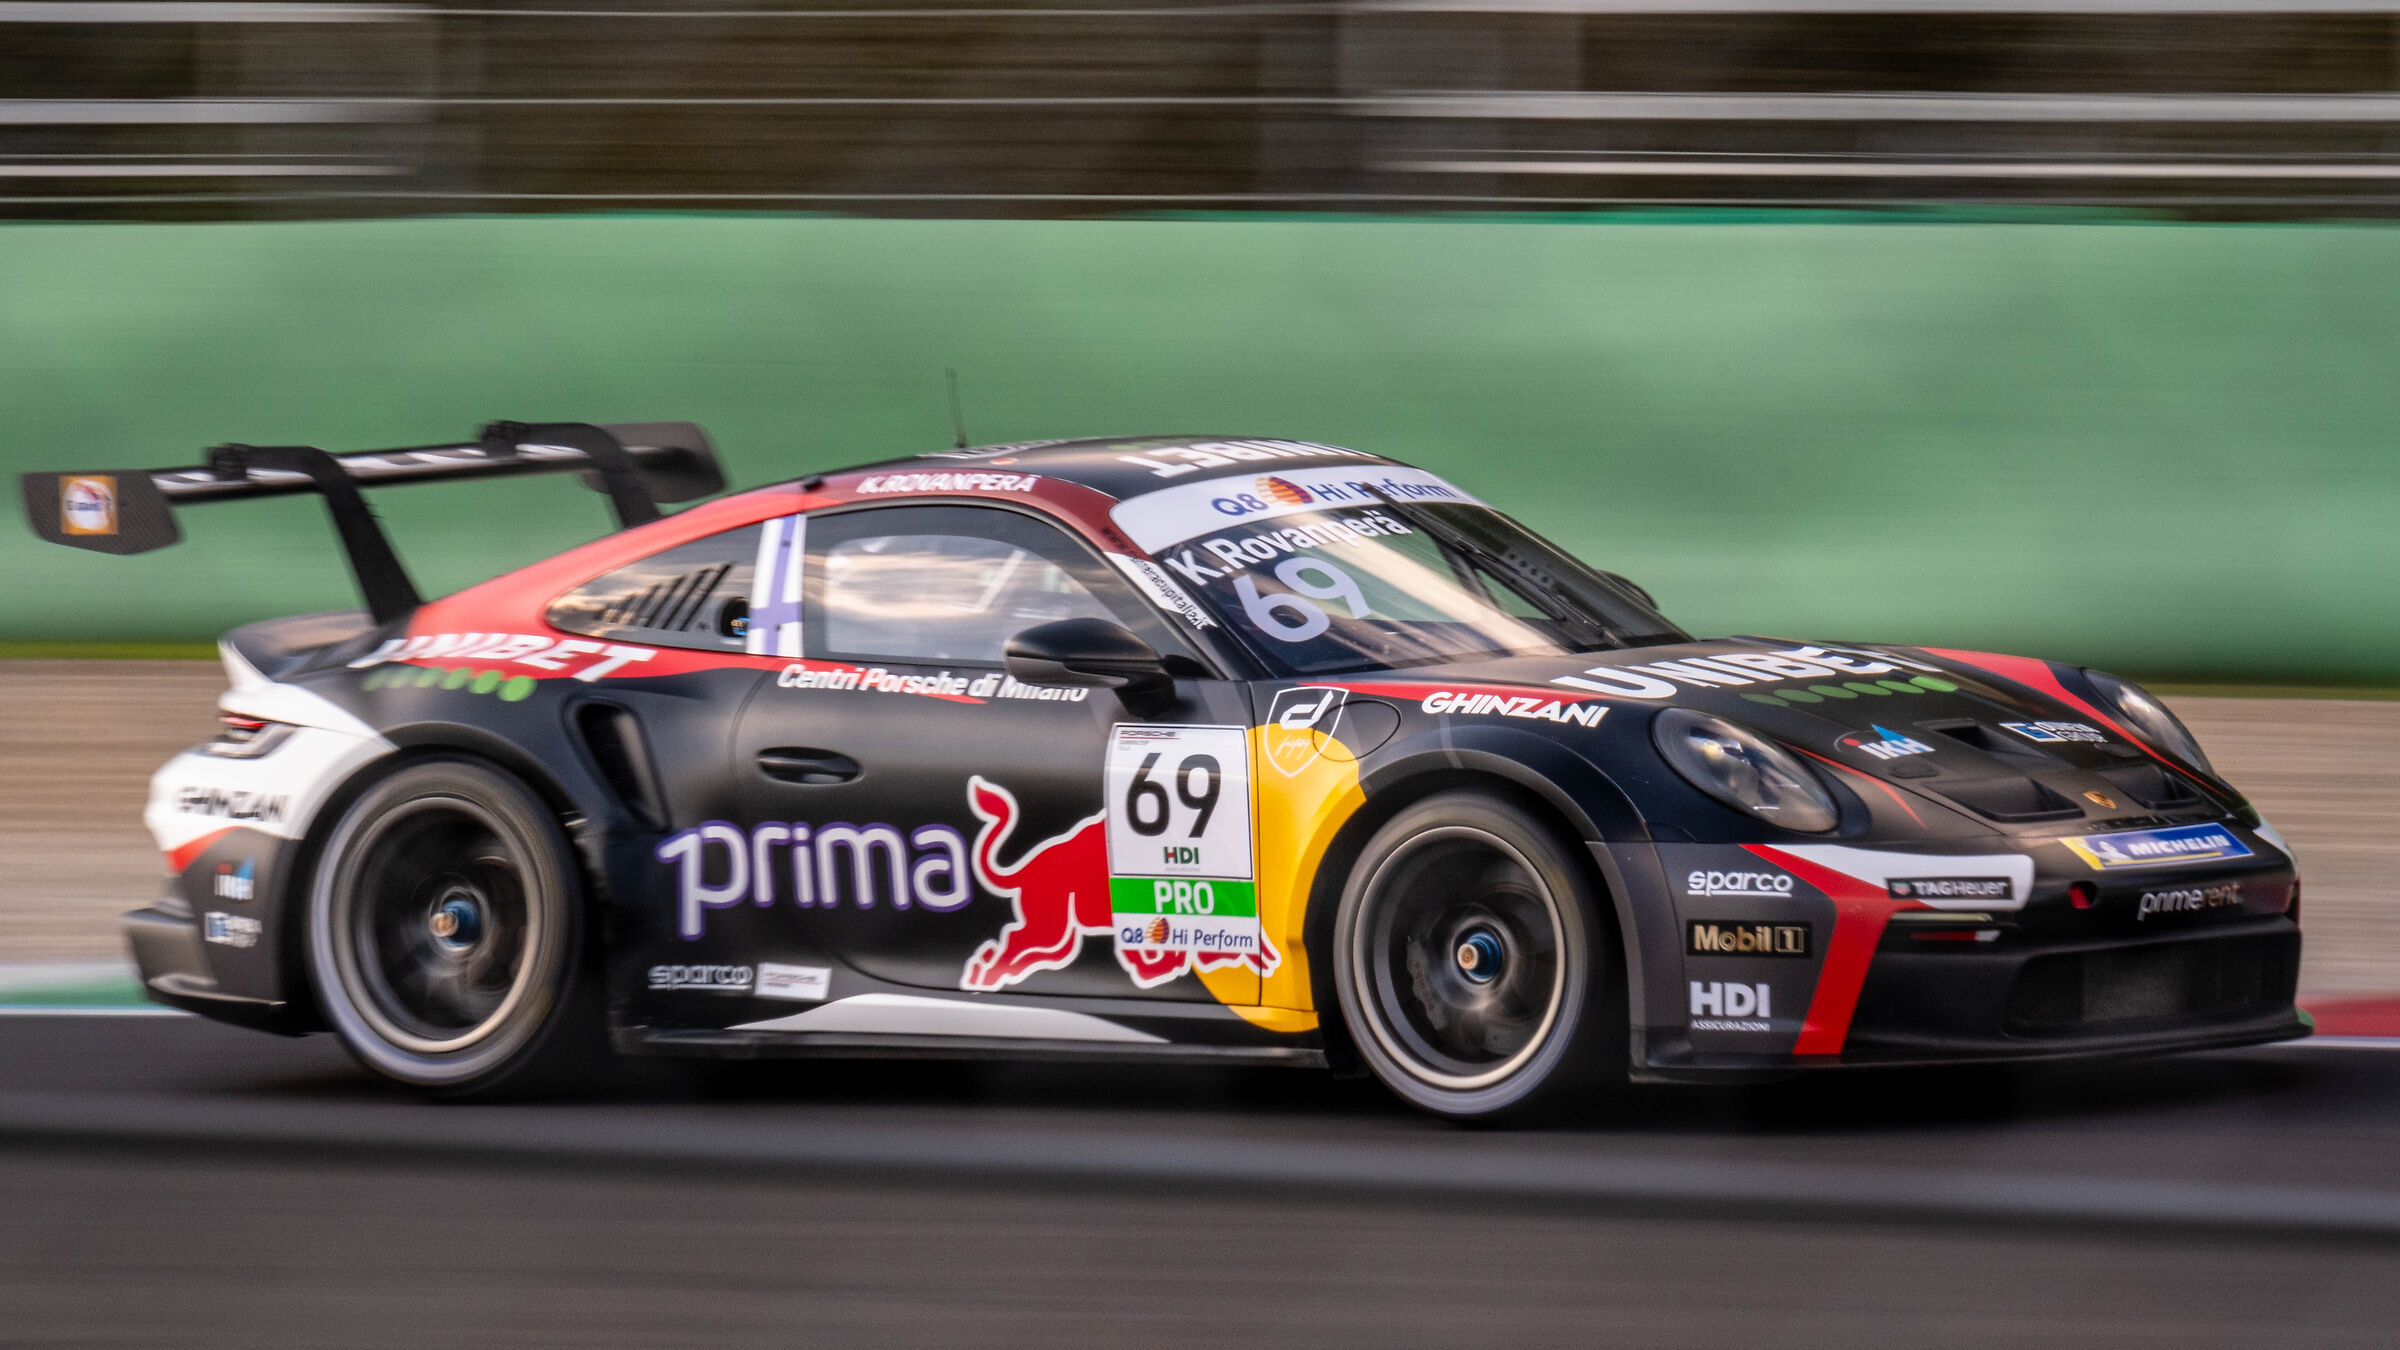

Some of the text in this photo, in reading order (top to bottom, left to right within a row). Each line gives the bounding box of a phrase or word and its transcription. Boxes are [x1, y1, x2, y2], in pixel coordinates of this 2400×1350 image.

[1211, 493, 1269, 516] Q8
[1307, 483, 1350, 502] Hi
[1165, 510, 1413, 586] K.Rovanperä
[1232, 556, 1372, 643] 69
[346, 632, 658, 683] UNIBET
[1549, 646, 1943, 699] UNIBET
[777, 664, 863, 690] Centri
[859, 668, 968, 697] Porsche
[968, 673, 1003, 697] di
[1421, 692, 1609, 728] GHINZANI
[1126, 753, 1221, 838] 69
[1163, 846, 1199, 865] HDI
[2127, 834, 2231, 856] MICHELIN
[656, 820, 973, 941] prima
[1688, 871, 1793, 897] sparco
[1154, 881, 1214, 914] PRO
[1121, 928, 1253, 950] Q8 Hi Perform
[1694, 925, 1798, 952] Mobil 1
[648, 965, 753, 990] sparco
[1690, 981, 1771, 1018] HDI
